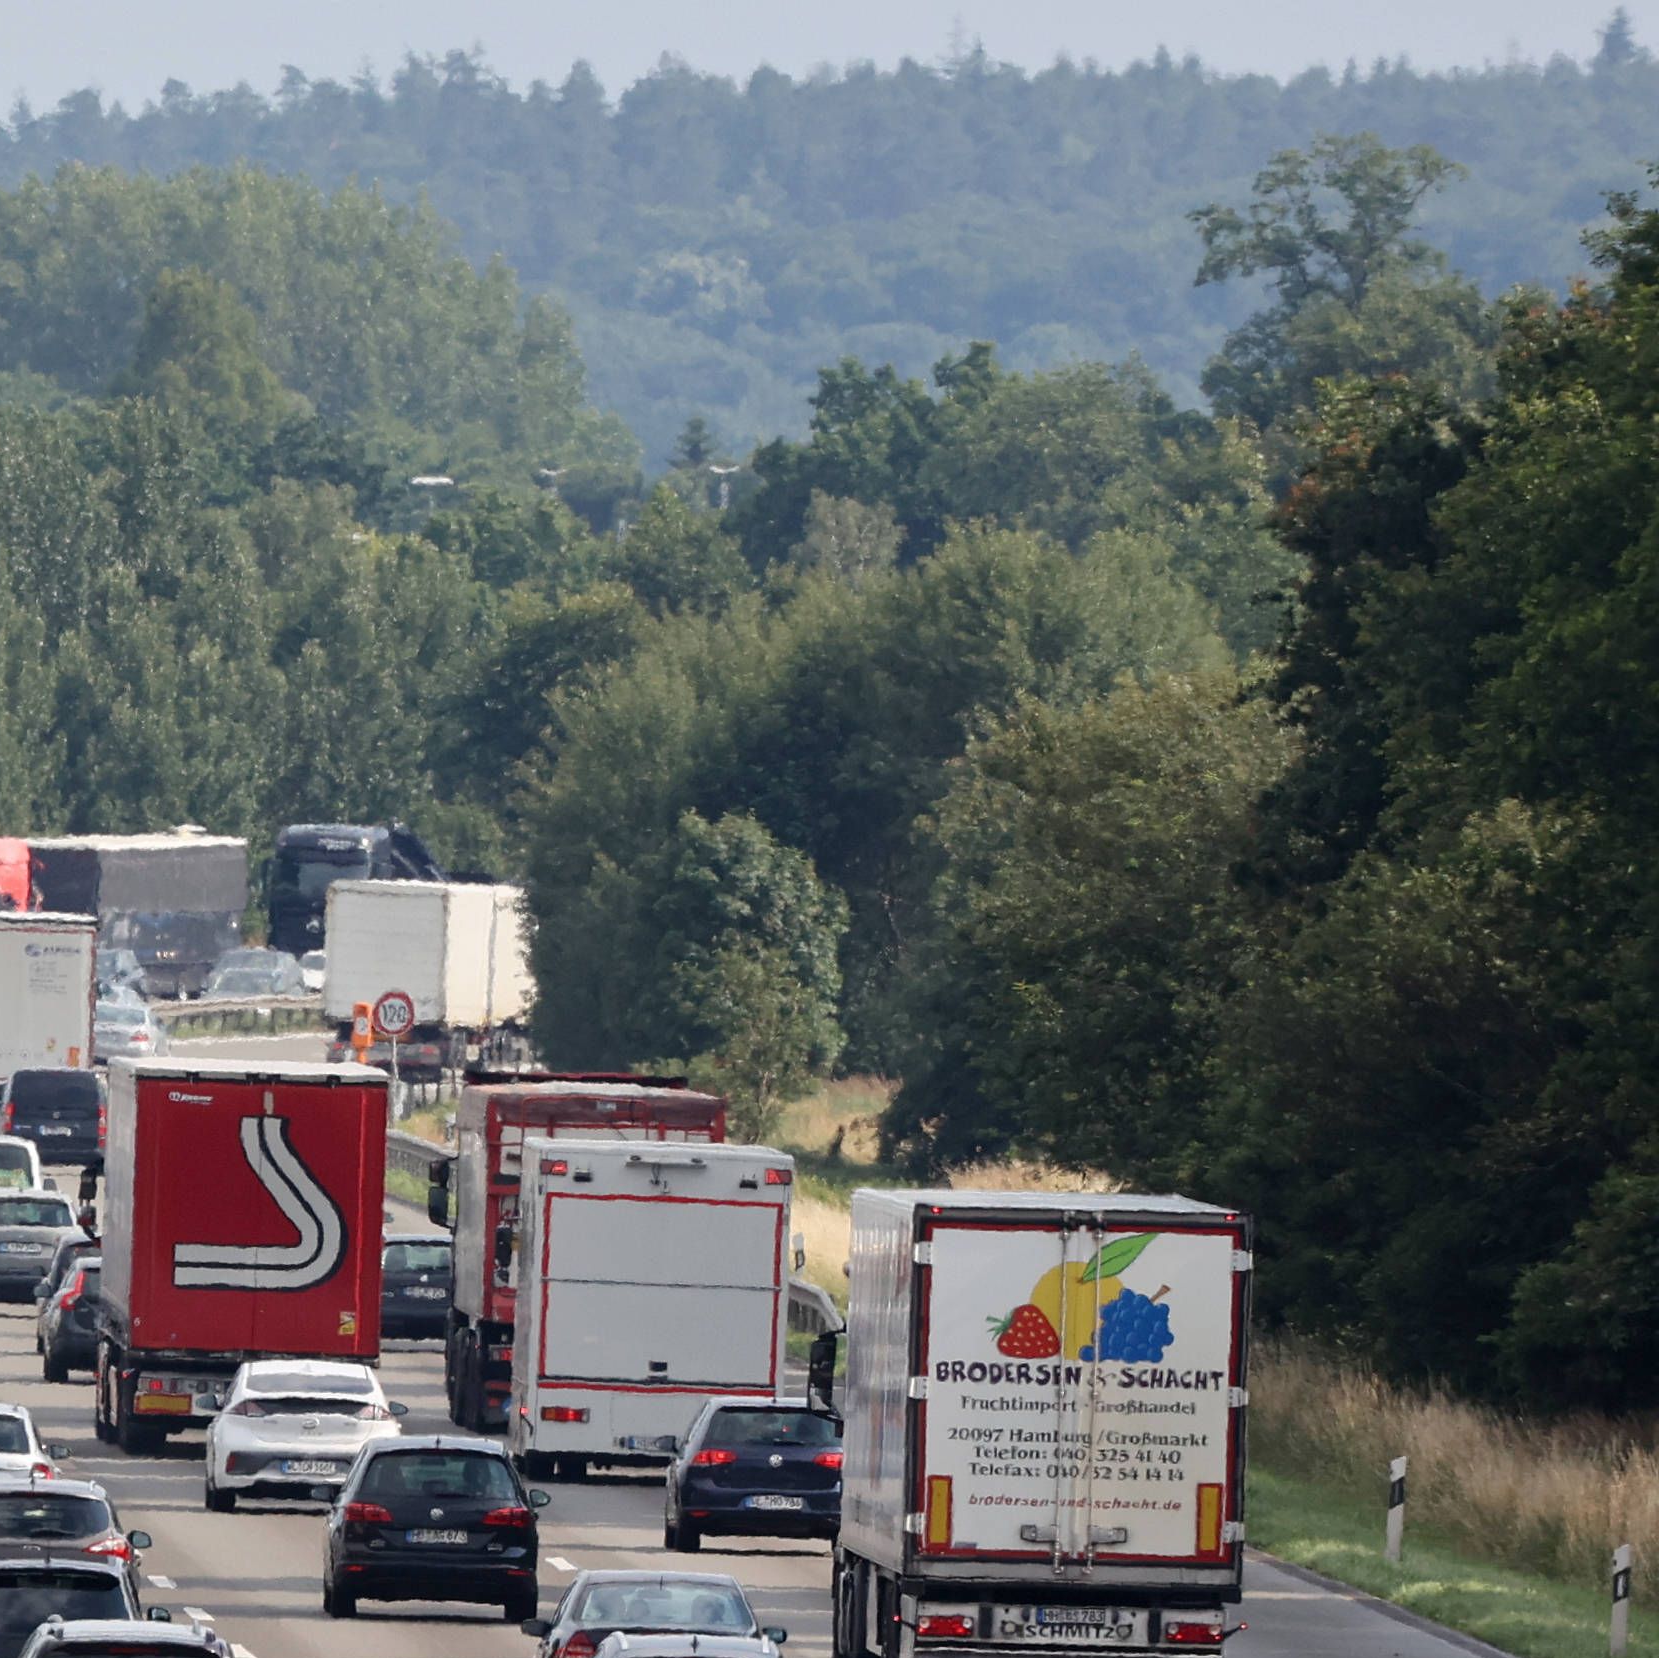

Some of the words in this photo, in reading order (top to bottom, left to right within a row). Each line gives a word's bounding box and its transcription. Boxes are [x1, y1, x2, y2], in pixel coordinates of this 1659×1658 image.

[382, 1003, 407, 1024] 120
[935, 1360, 1082, 1386] BRODERSEN
[1117, 1367, 1224, 1391] SCHACHT
[961, 1395, 1077, 1414] Fruchtimport
[1094, 1400, 1196, 1415] Großhandel
[948, 1427, 1004, 1442] 20097
[975, 1446, 1047, 1460] Telefon:
[1158, 1450, 1182, 1465] 40
[969, 1462, 1040, 1478] Telefax:
[1025, 1624, 1114, 1640] SCHMITZ
